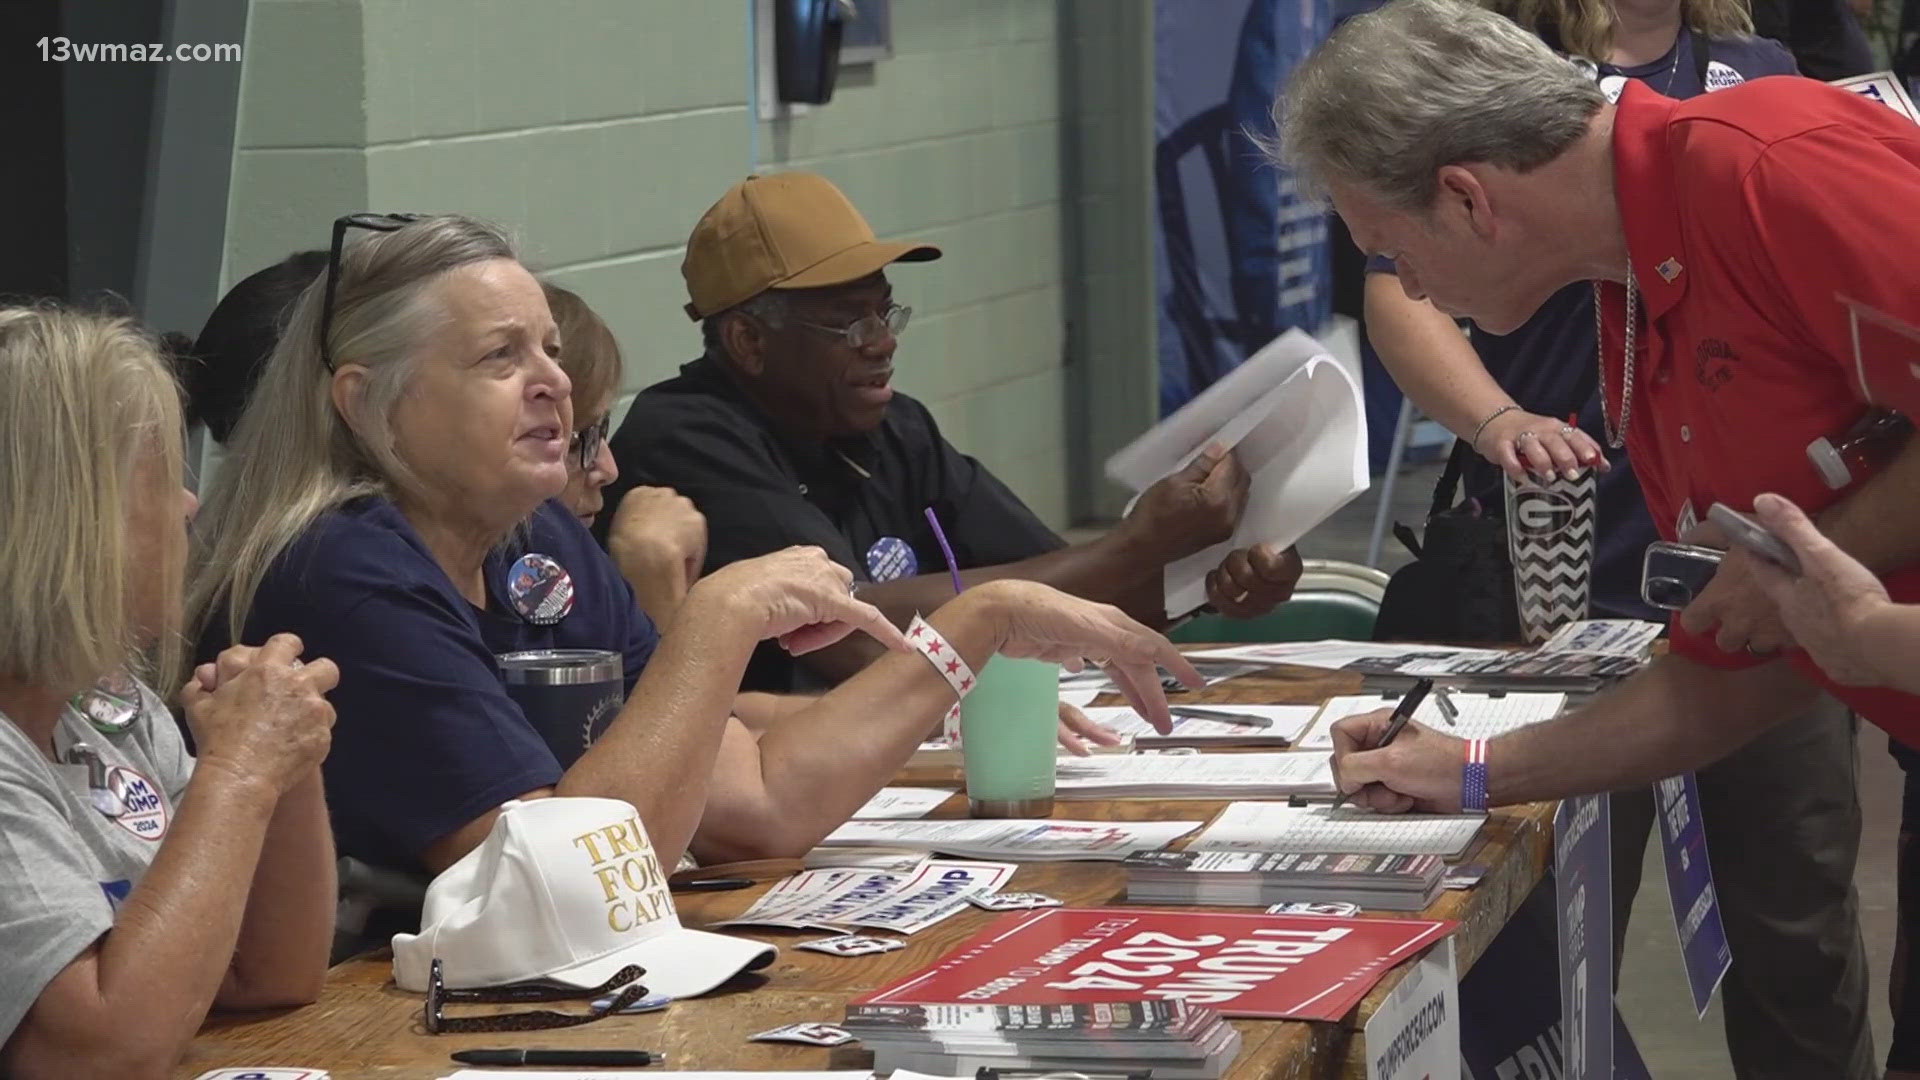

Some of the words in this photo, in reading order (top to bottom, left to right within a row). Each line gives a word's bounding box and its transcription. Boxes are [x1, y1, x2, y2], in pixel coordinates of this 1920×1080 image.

[125, 780, 148, 797] AM
[128, 795, 159, 812] UMP
[572, 817, 649, 867] TRU
[592, 854, 662, 904] FOR
[607, 889, 675, 933] CAPT
[1083, 917, 1139, 938] TEXT
[1034, 938, 1102, 965] TRUMP
[1043, 931, 1227, 992] 2024
[1142, 928, 1354, 1004] TRUMP
[1008, 966, 1051, 978] TO
